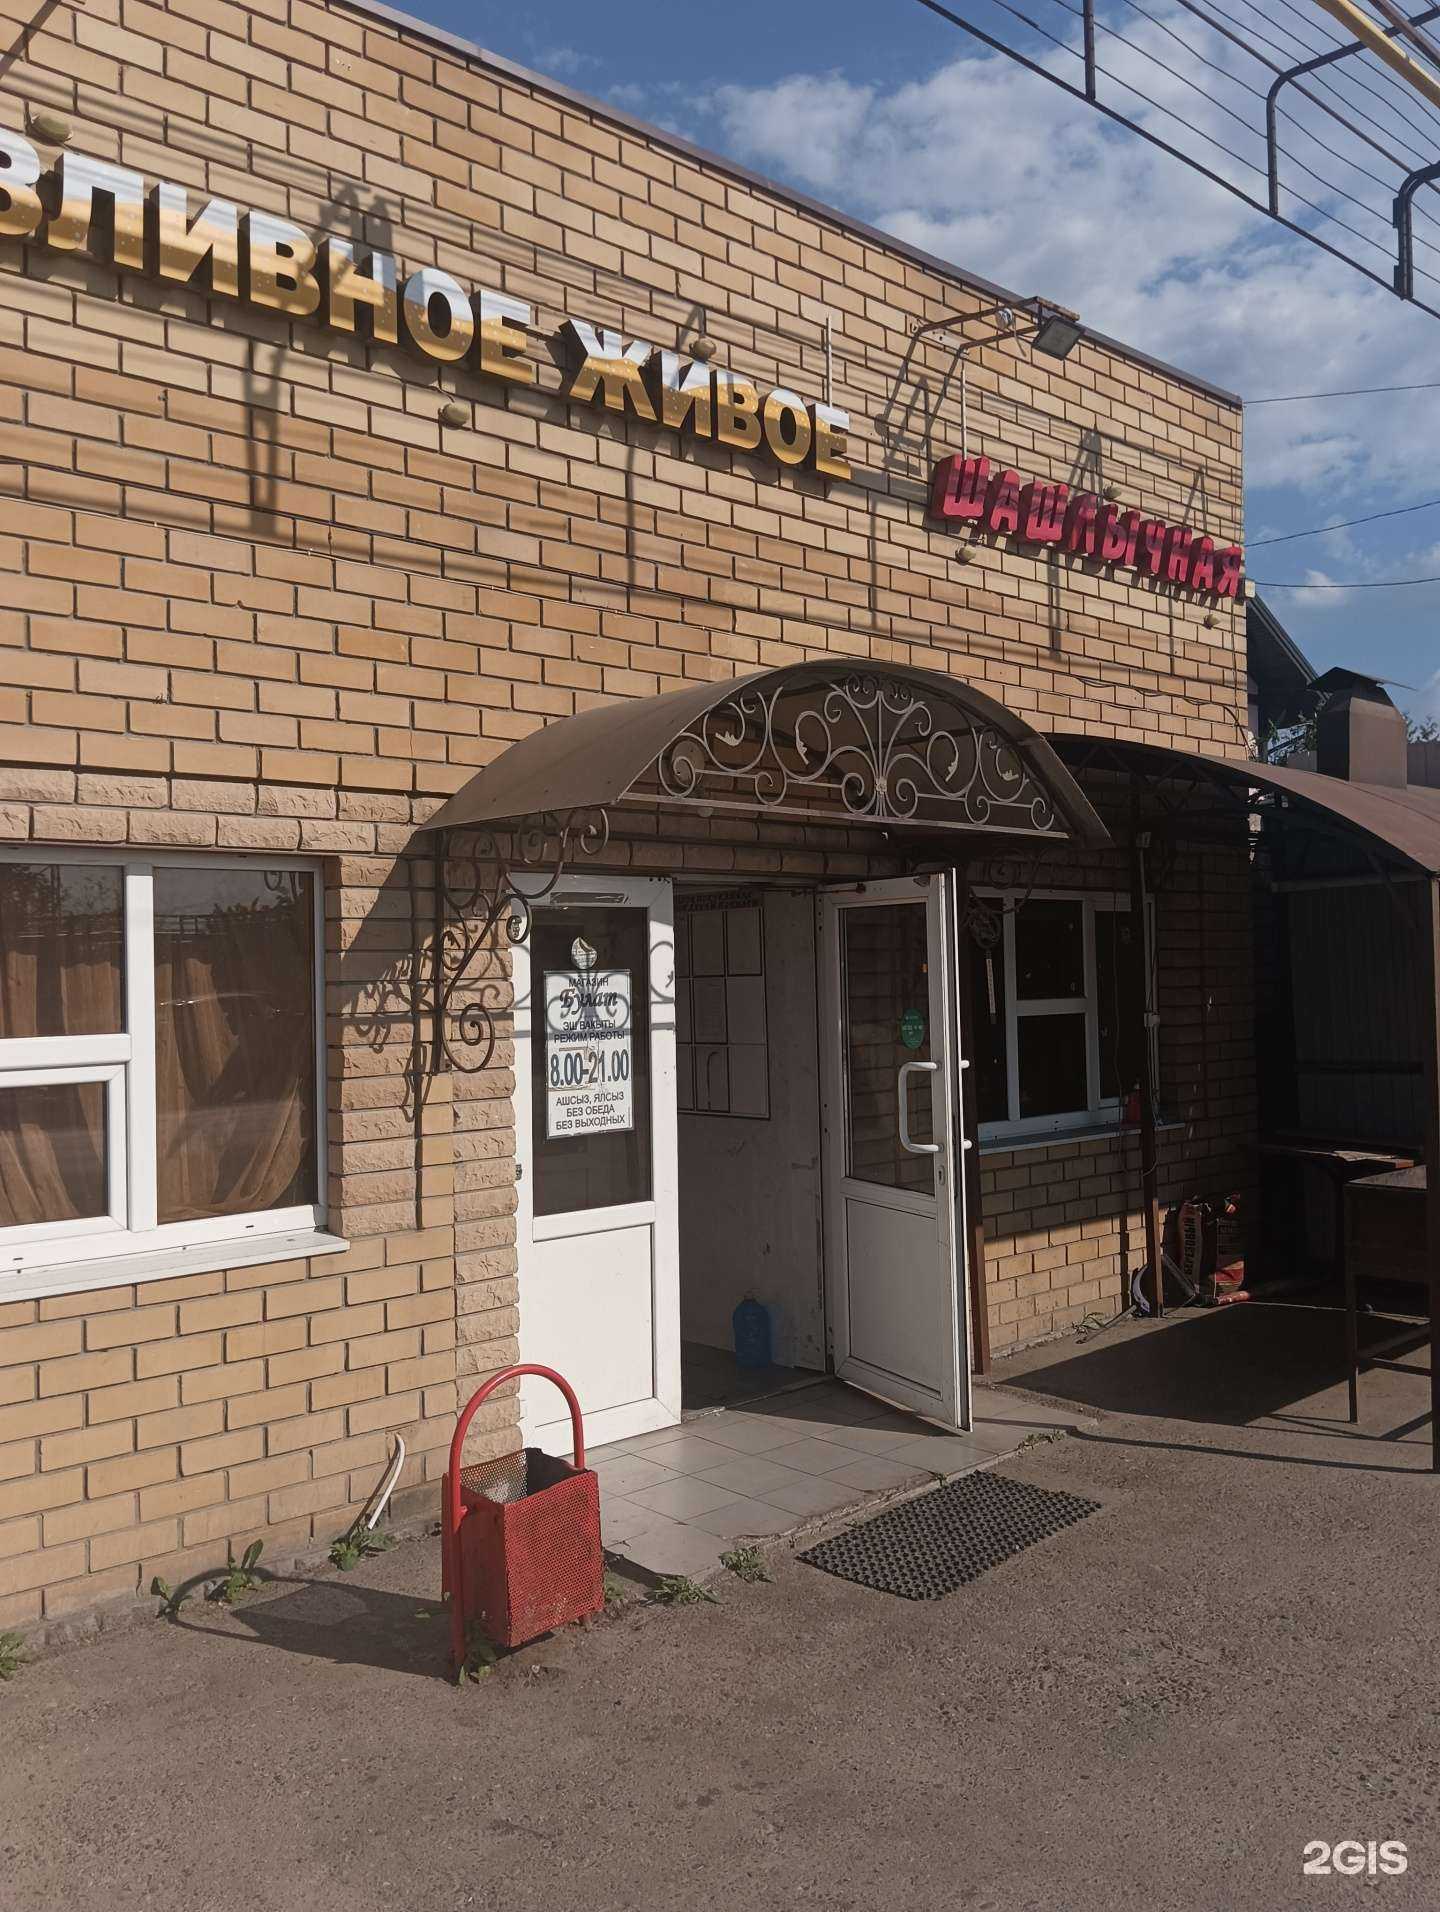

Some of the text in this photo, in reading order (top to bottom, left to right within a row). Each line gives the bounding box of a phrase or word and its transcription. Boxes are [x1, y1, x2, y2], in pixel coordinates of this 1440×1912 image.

[560, 318, 852, 480] ЖИВОЕ
[934, 453, 1244, 598] ШАШЛЫЧНАЯ
[568, 977, 609, 987] МАГАЗИН
[560, 988, 618, 1015] Булат
[563, 1019, 616, 1031] ЭШ ВАКЫТЫ
[554, 1030, 625, 1043] РЕЖИМ РАБОТЫ
[551, 1049, 629, 1087] 8.00-21.00
[556, 1091, 625, 1106] АШСЫЗ, ЯЛСЫЗ
[566, 1103, 615, 1117] БЕЗ ОБЕДА
[555, 1114, 626, 1130] БЕЗ ВЫХОДНЫХ
